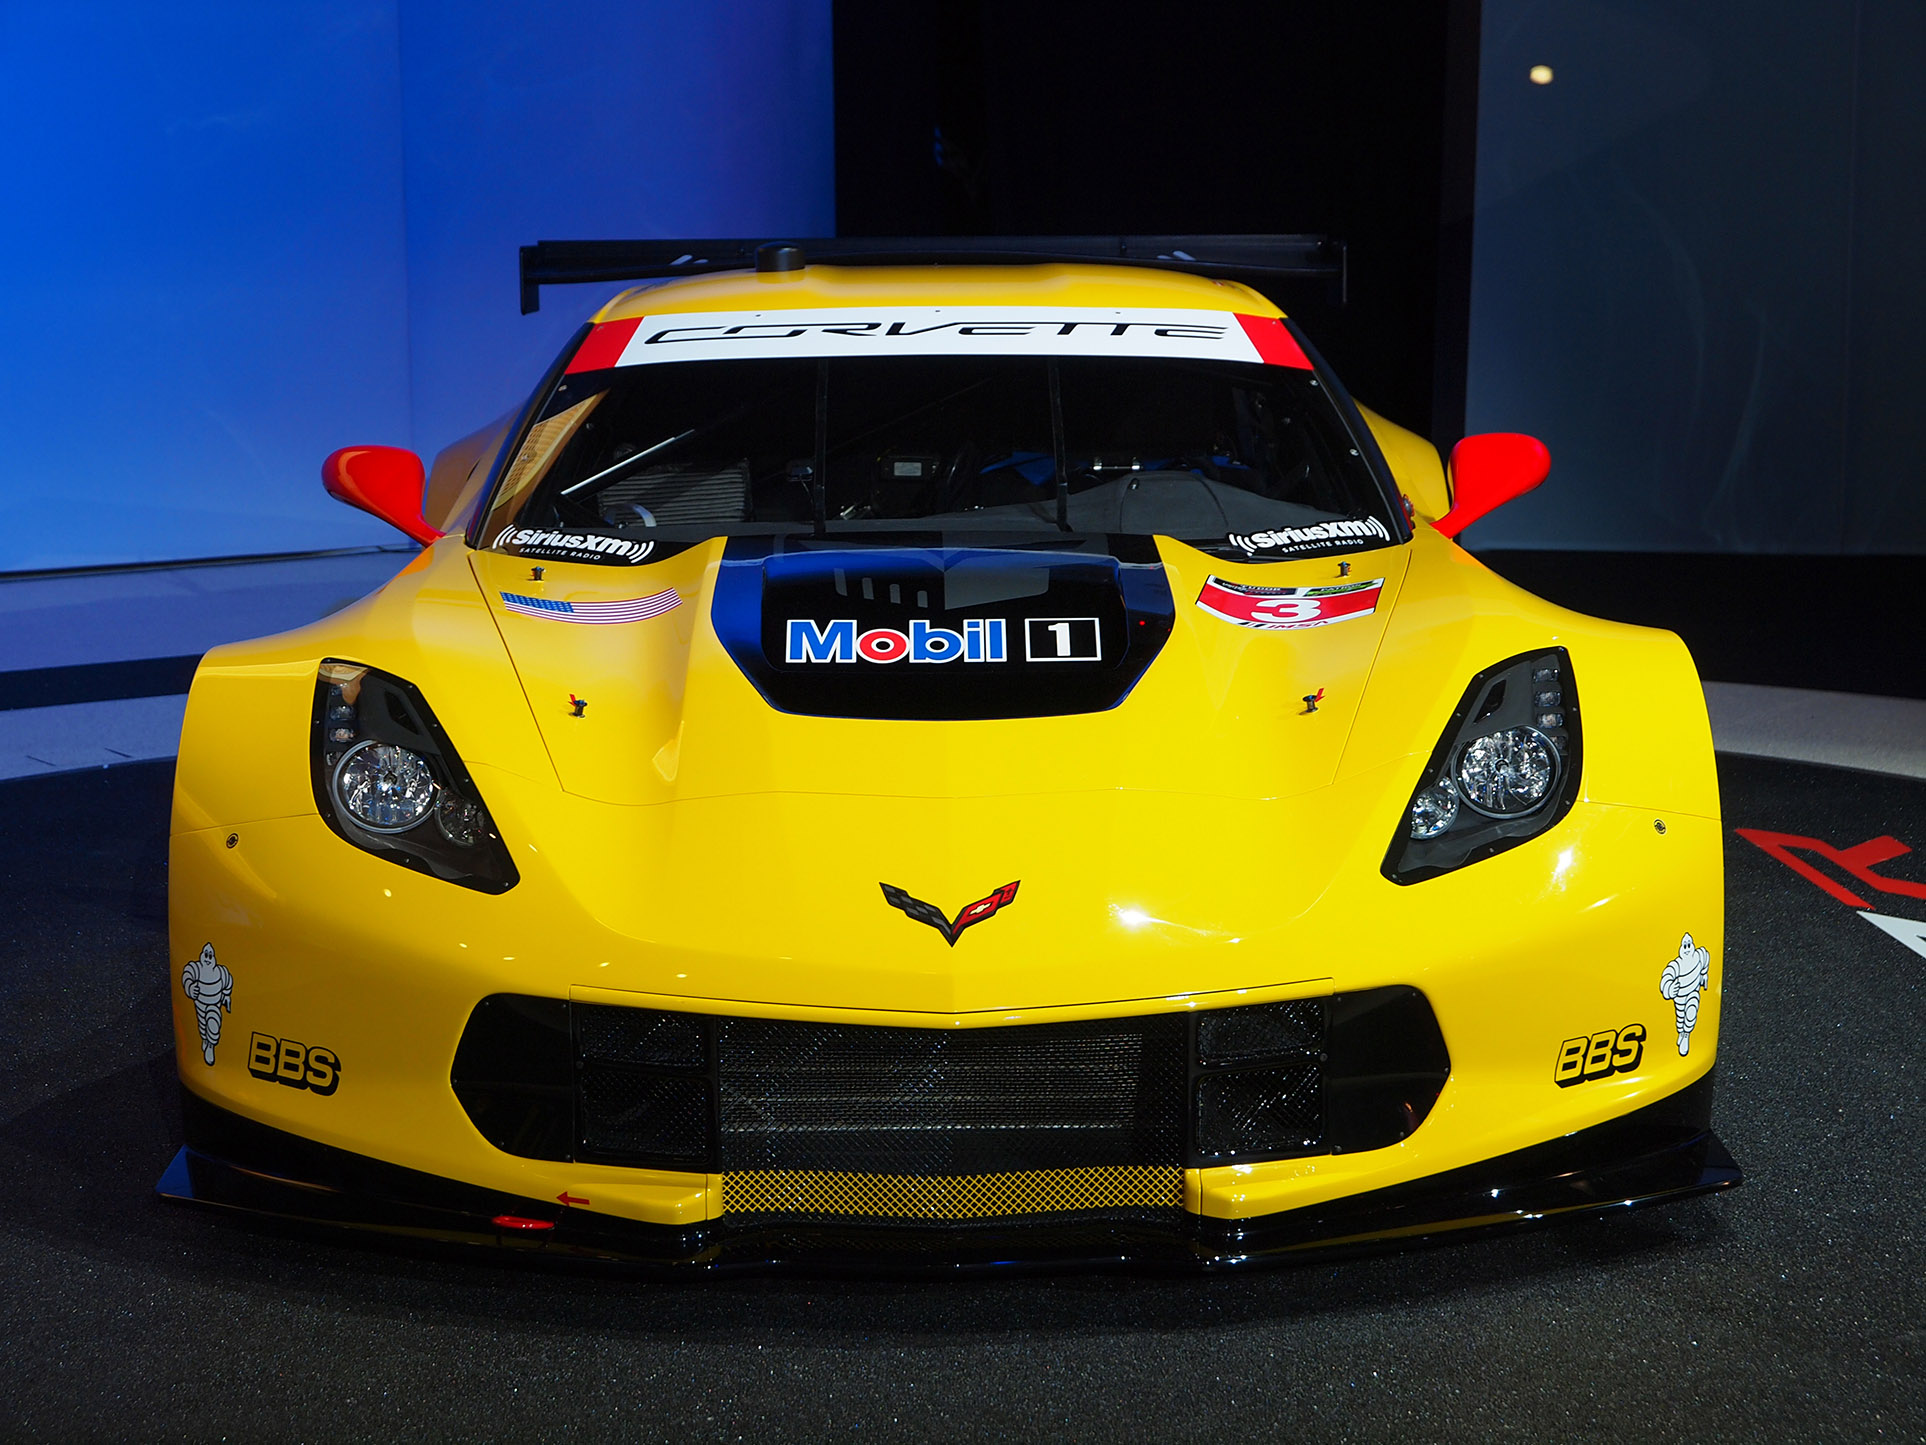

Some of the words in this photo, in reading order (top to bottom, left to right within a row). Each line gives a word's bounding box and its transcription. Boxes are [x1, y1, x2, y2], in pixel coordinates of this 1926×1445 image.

[644, 321, 1229, 345] CORVETTE
[518, 547, 568, 556] SATELLITE
[570, 551, 601, 560] RADIO
[1281, 541, 1333, 553] SATELLITE
[1335, 538, 1364, 547] RADIO
[1250, 599, 1322, 623] 3
[785, 618, 1007, 664] Mobil
[1047, 622, 1072, 657] 1
[248, 1031, 342, 1097] BBS
[1554, 1023, 1647, 1089] BBS
